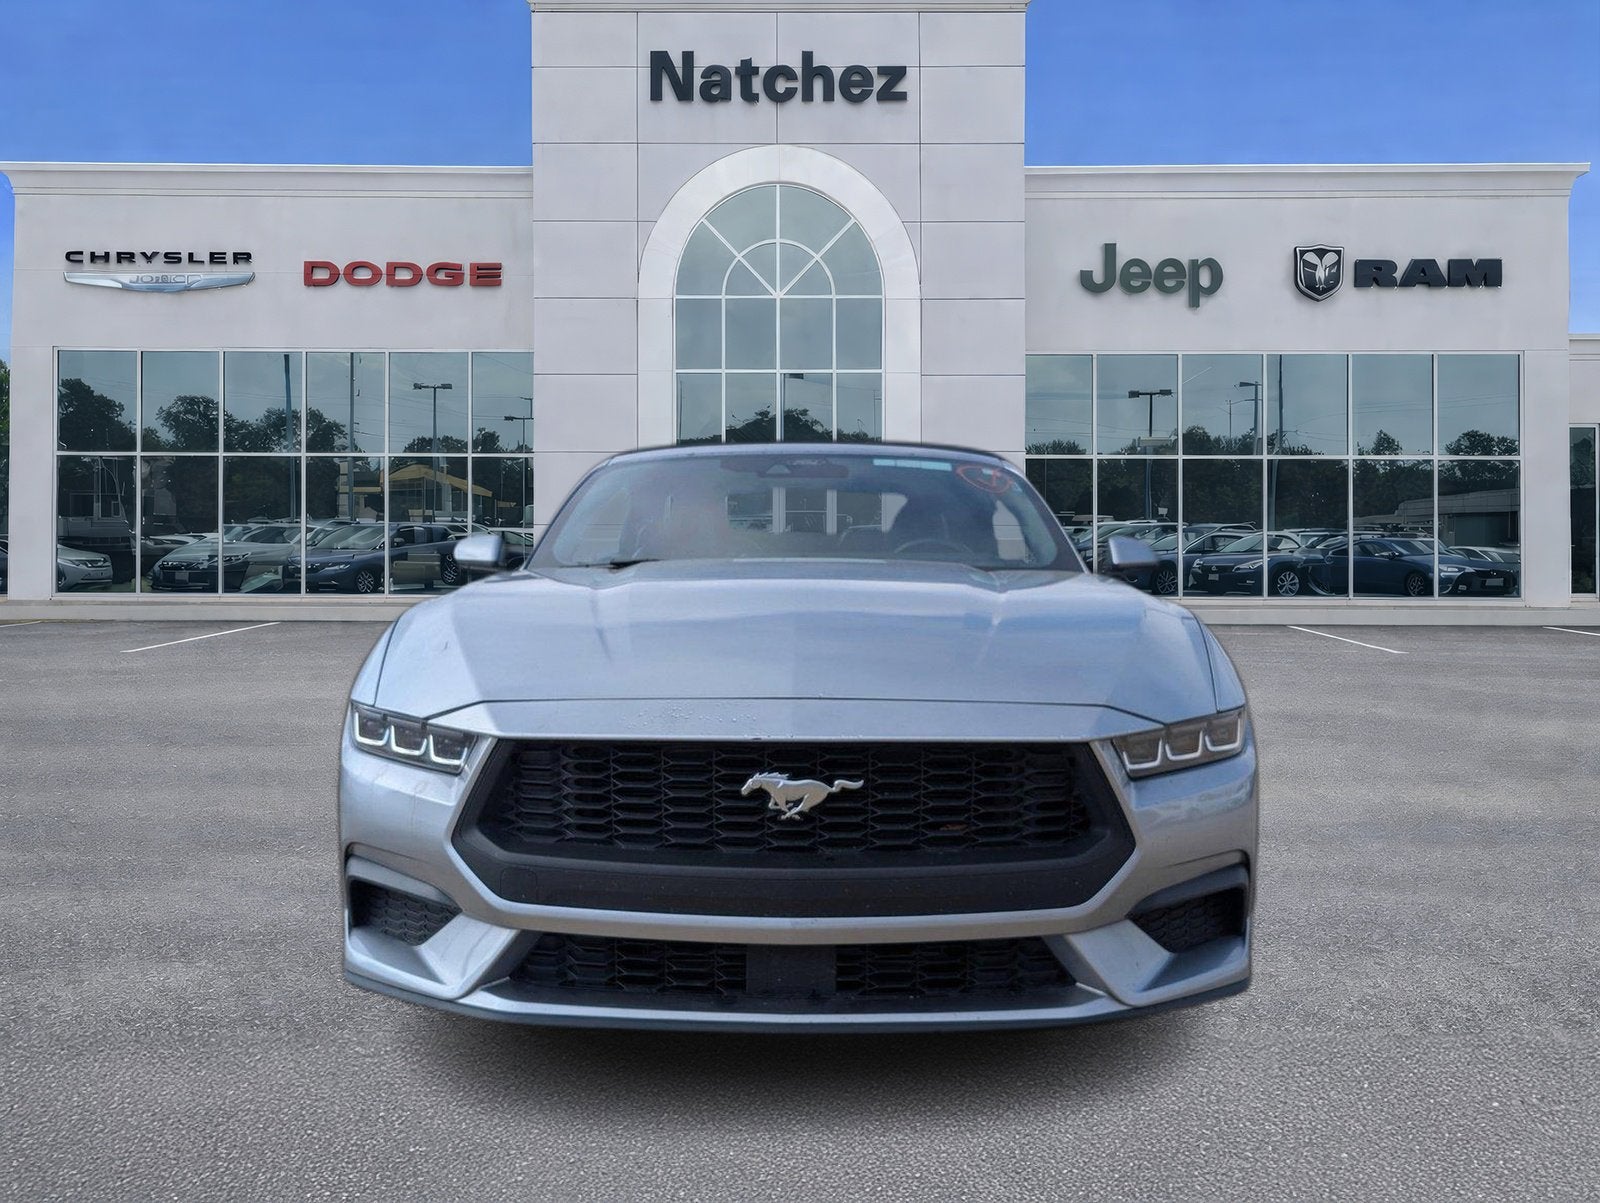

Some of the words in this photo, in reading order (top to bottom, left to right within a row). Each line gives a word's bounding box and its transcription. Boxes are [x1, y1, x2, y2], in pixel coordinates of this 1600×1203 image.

[650, 51, 907, 103] Natchez
[65, 250, 253, 265] CHRYSLER
[304, 261, 503, 287] DODGE
[1079, 243, 1224, 308] Jeep
[1354, 258, 1503, 288] RAM
